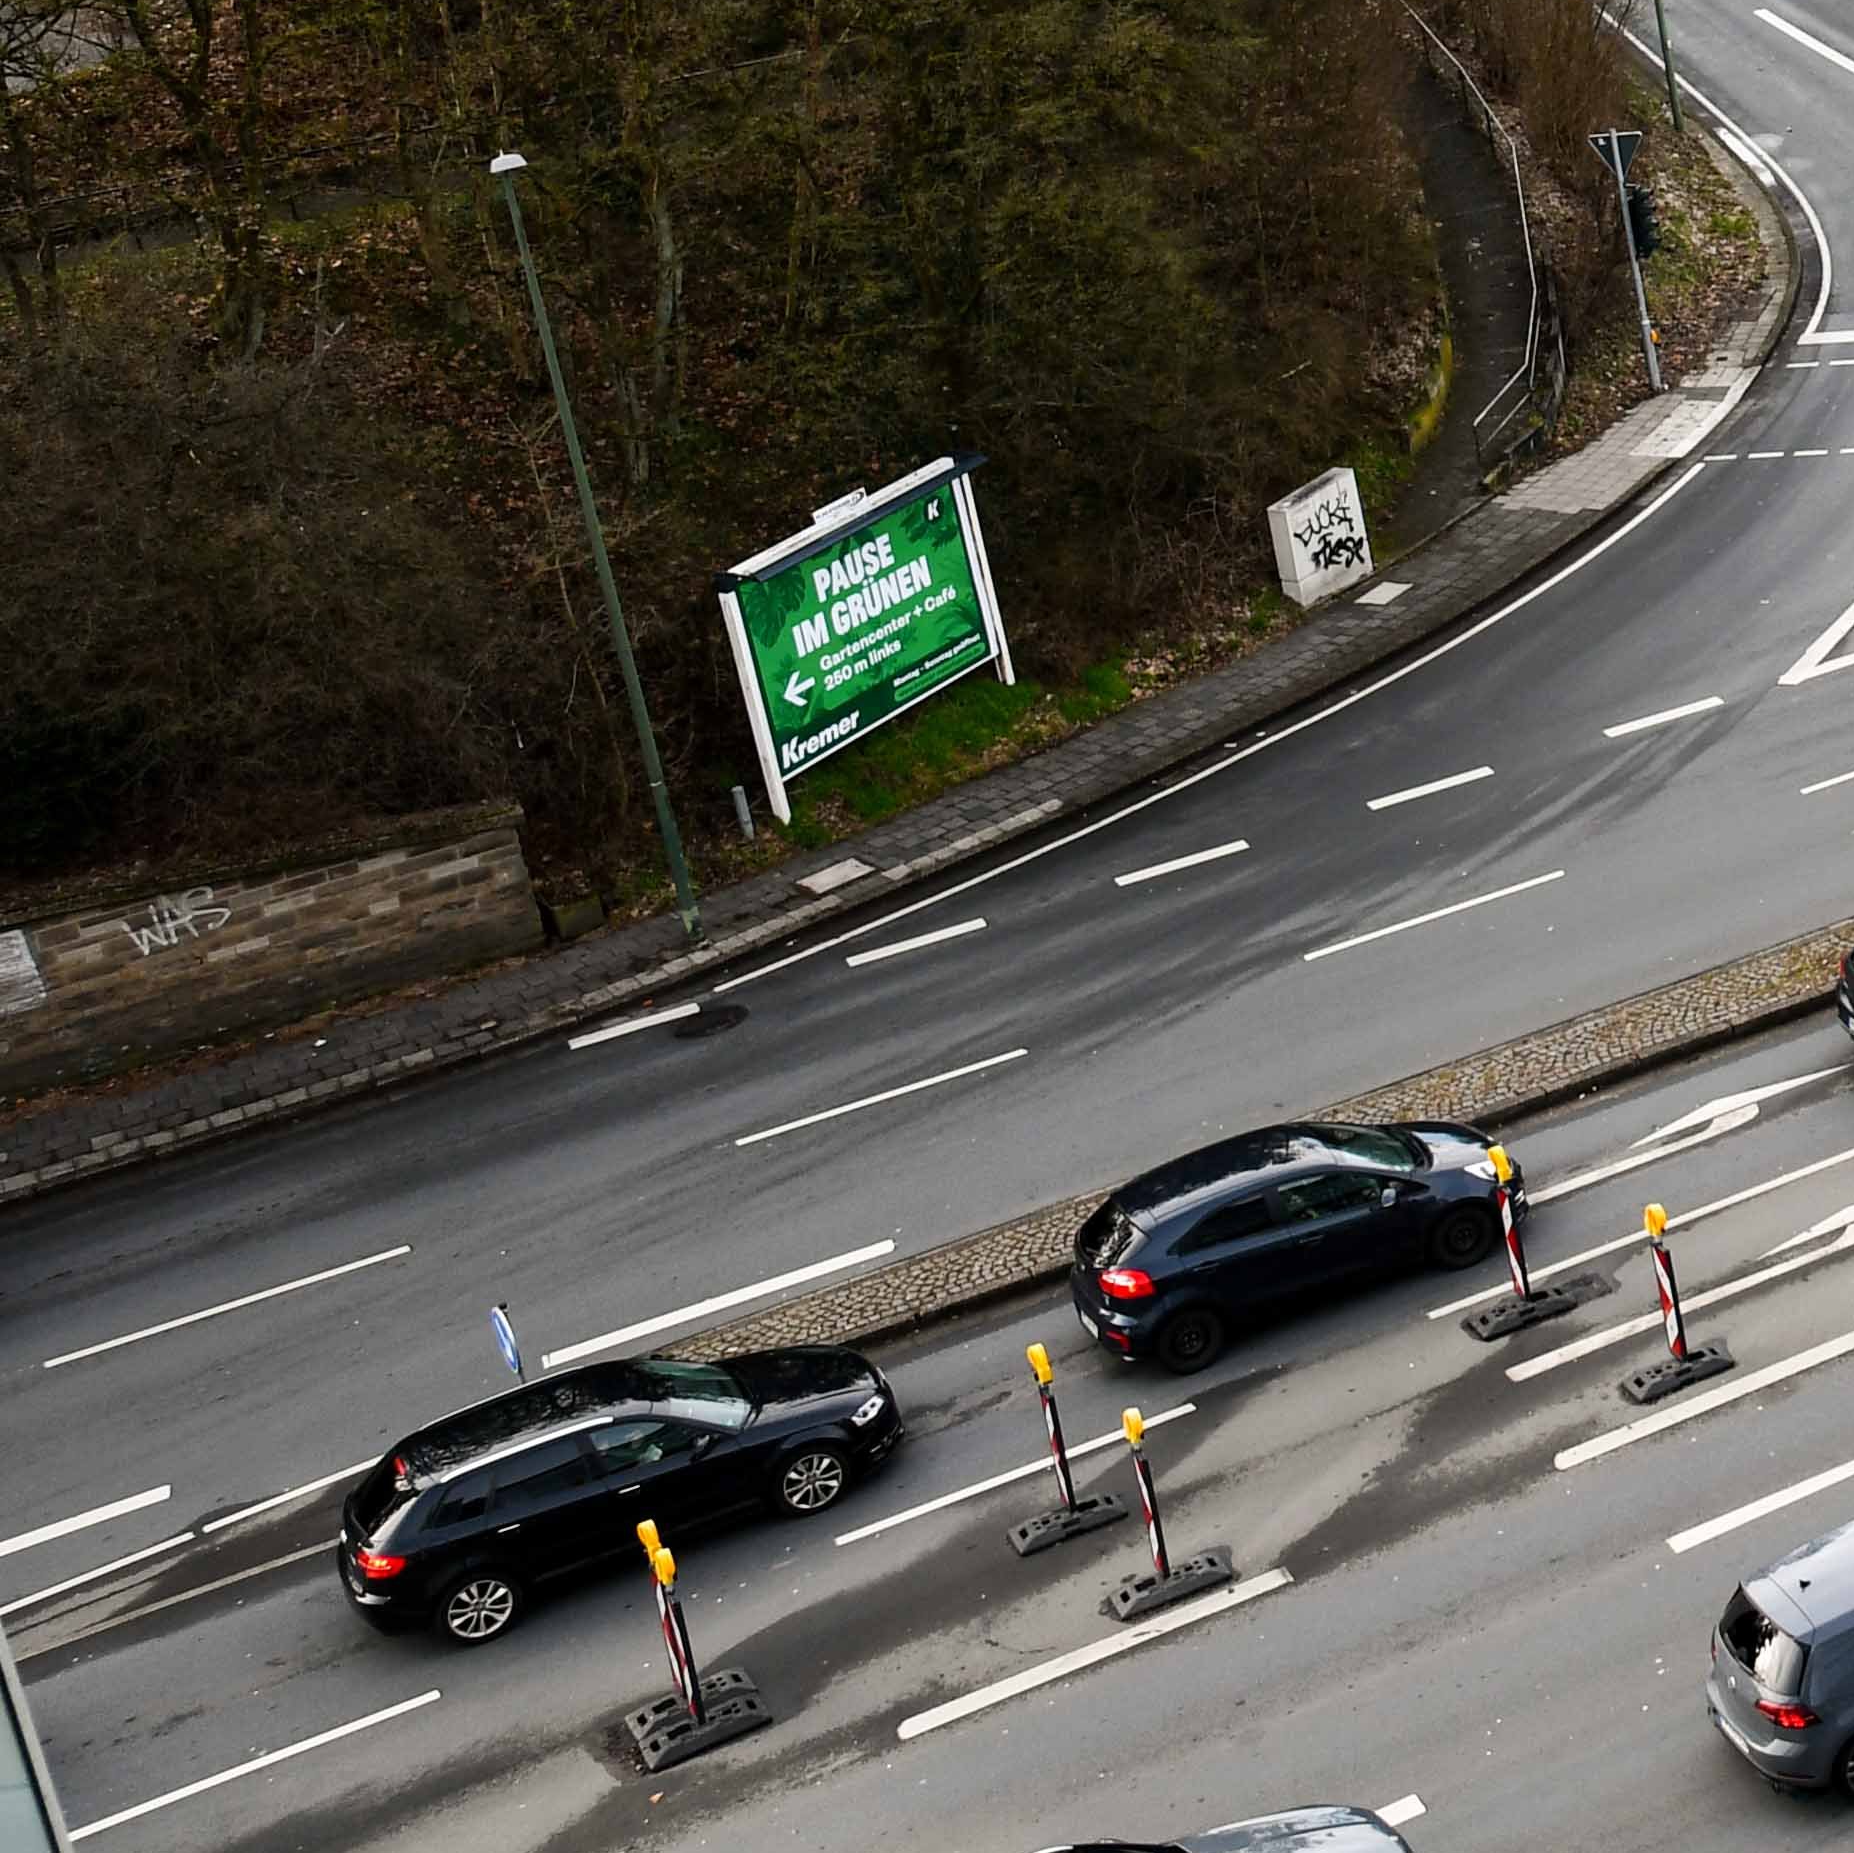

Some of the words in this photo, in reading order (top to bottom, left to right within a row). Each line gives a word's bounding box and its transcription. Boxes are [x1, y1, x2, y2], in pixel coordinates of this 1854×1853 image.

[812, 532, 896, 604] PAUSE
[791, 611, 830, 659] IM
[830, 555, 933, 636] GRÜNEN
[819, 612, 913, 671] Gartencenter
[923, 584, 957, 613] Café
[823, 665, 854, 692] 250
[853, 658, 870, 675] m
[868, 639, 903, 666] links
[780, 709, 861, 770] Kremer
